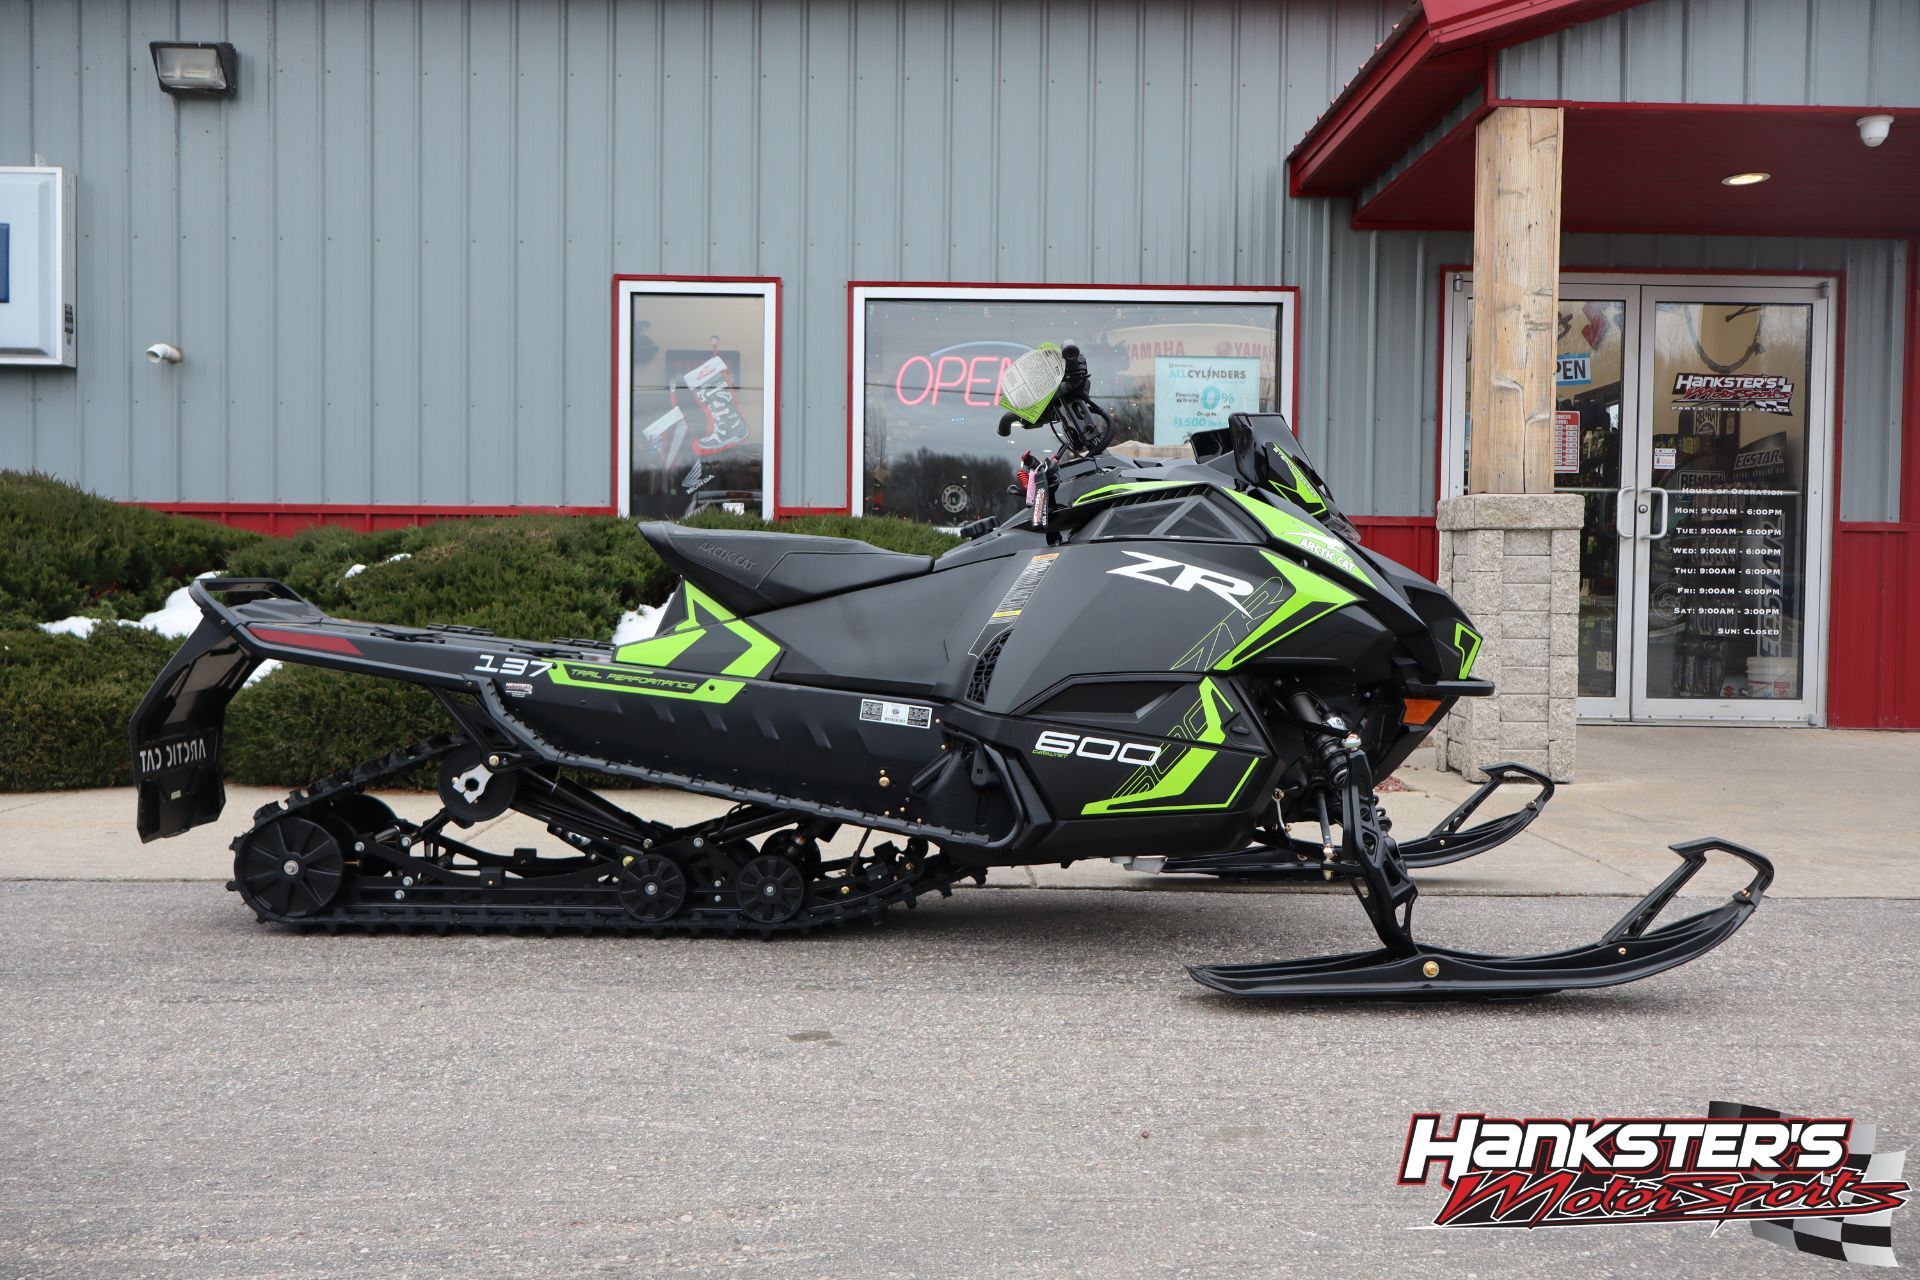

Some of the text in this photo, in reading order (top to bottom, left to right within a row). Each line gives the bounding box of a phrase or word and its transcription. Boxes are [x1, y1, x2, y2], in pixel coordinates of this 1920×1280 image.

[1234, 342, 1275, 361] YAMAH
[1556, 359, 1586, 380] PEN
[1175, 391, 1200, 400] Financing
[1208, 418, 1229, 428] Reba
[1701, 507, 1737, 515] 9:00AM
[1746, 508, 1782, 516] 6:00PM
[1700, 527, 1737, 535] 9:00AM
[1746, 528, 1782, 536] 6:00PM
[697, 541, 757, 571] ARCTIC CAT
[1299, 538, 1356, 573] ARCTIC CAT
[1699, 547, 1736, 555] 9:00AM
[1699, 567, 1736, 575] 9:00AM
[1745, 568, 1781, 576] 6:00PM
[1105, 550, 1255, 620] ZR
[1698, 587, 1735, 595] 9:00AM
[1698, 607, 1734, 615] 9:00AM
[474, 654, 554, 677] 137
[571, 668, 698, 690] TRAIL PERFORMANCE
[1034, 730, 1162, 766] 600
[1032, 749, 1069, 759] CATALYST
